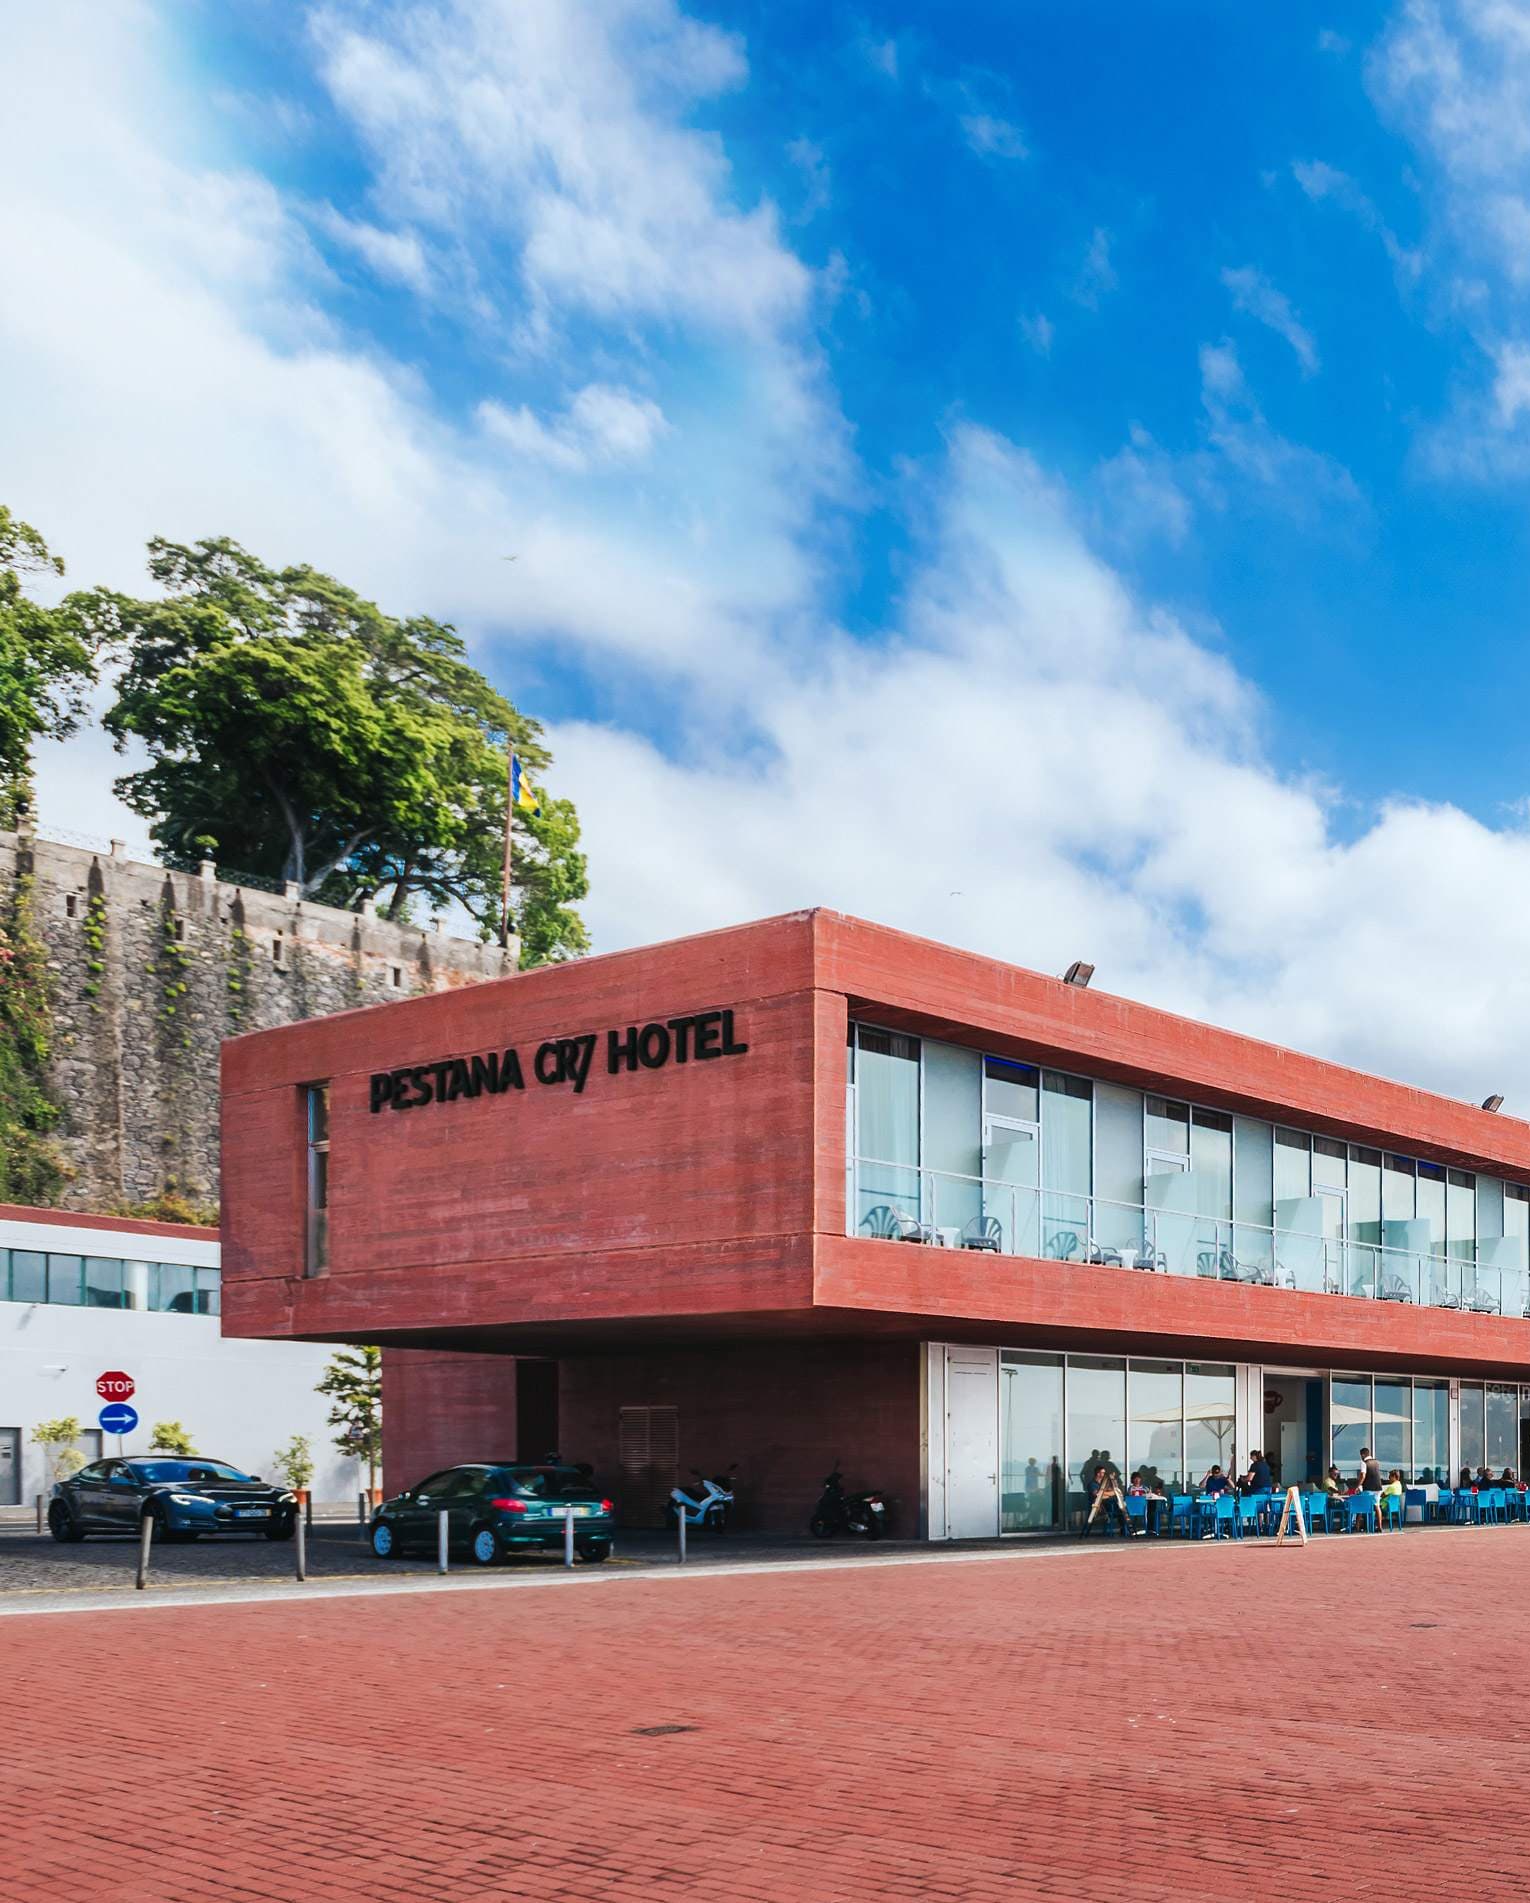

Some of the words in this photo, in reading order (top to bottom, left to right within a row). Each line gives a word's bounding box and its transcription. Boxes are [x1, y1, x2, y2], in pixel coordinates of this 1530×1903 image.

[370, 1049, 525, 1113] PESTANA
[534, 1034, 597, 1093] CR7
[607, 1009, 748, 1074] HOTEL
[97, 1381, 134, 1392] STOP
